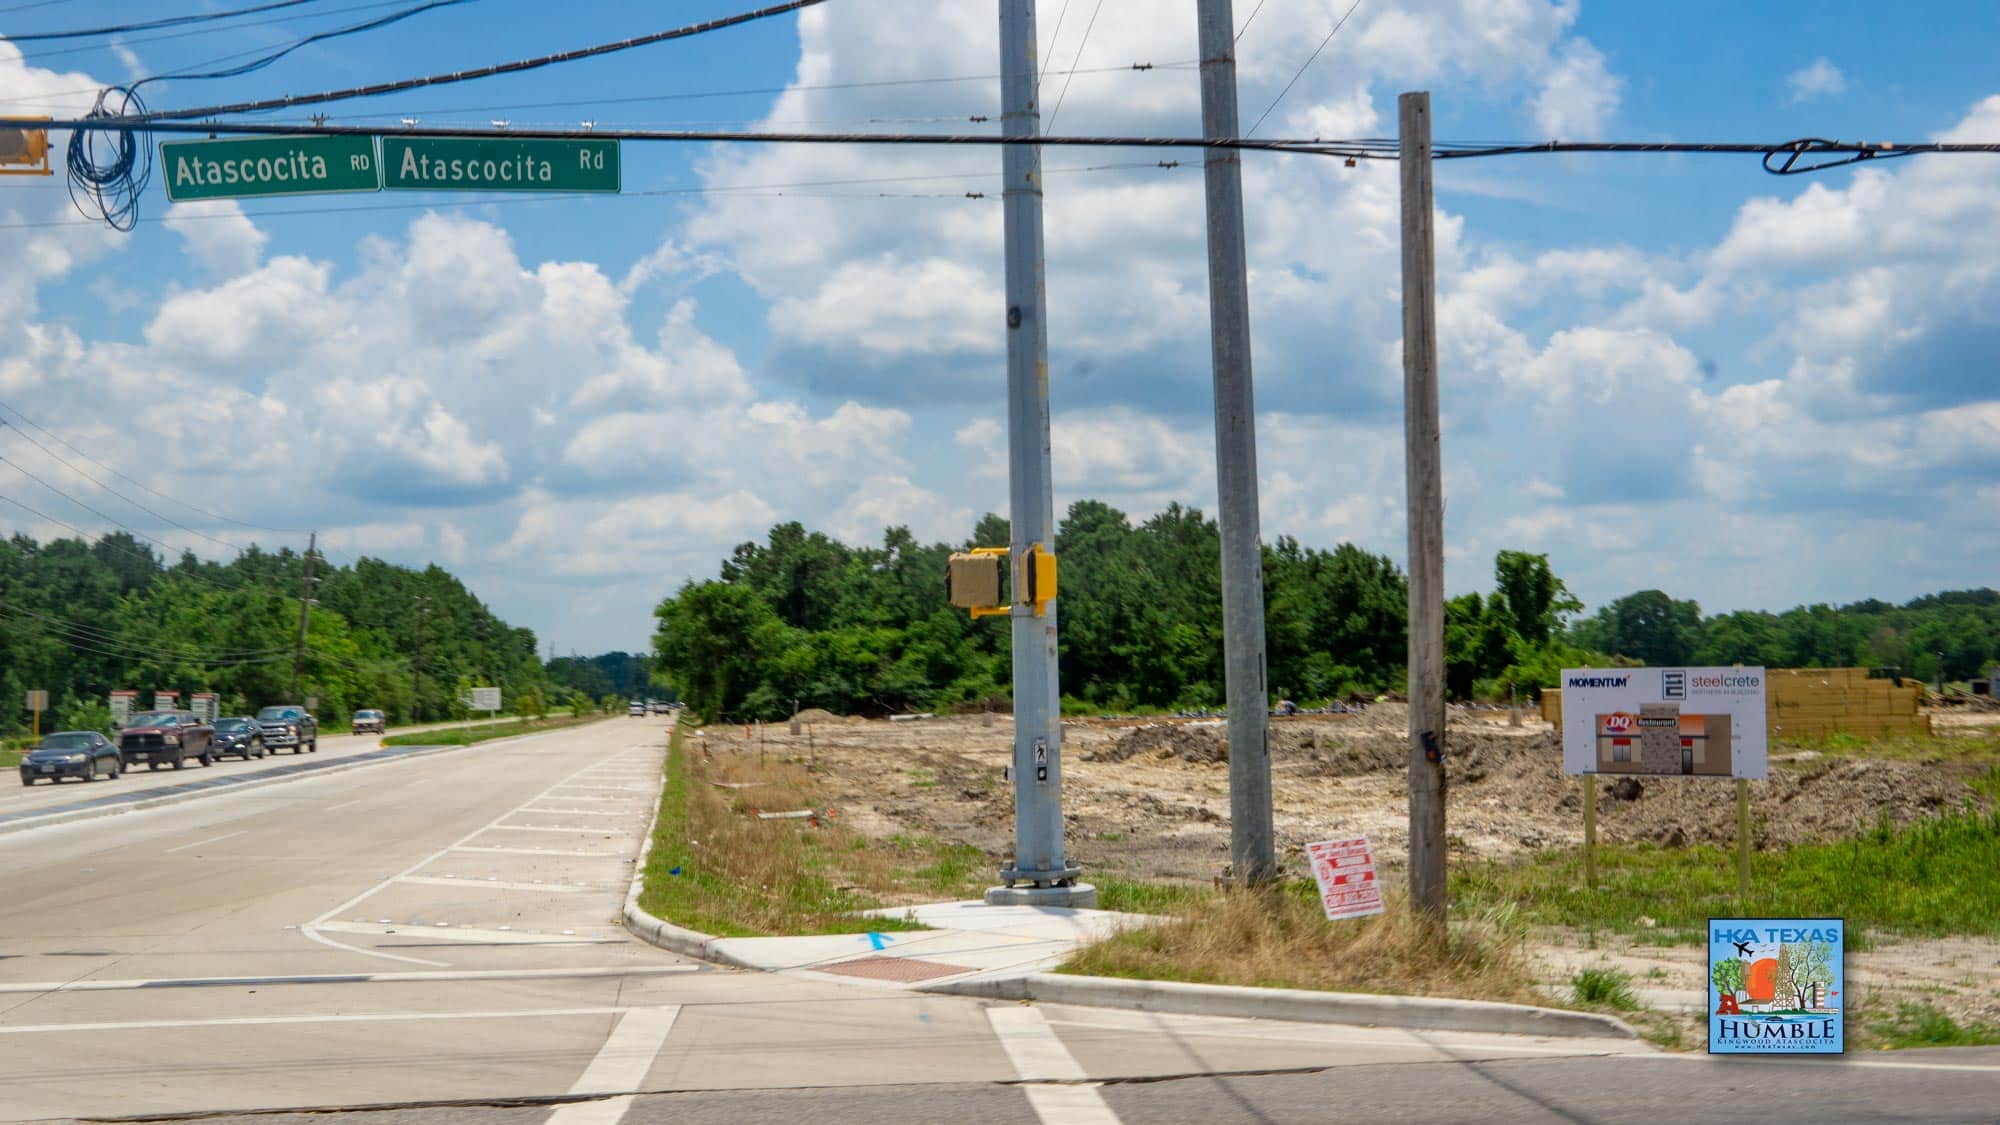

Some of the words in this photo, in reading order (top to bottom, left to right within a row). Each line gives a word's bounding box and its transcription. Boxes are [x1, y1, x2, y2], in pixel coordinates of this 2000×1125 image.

[175, 150, 328, 188] Atascocita
[350, 153, 371, 172] RD
[400, 147, 553, 182] Atascocita
[580, 150, 604, 171] Rd
[1569, 677, 1627, 689] MOMENTUM
[1692, 674, 1760, 687] steelcrete
[1610, 715, 1631, 729] DQ
